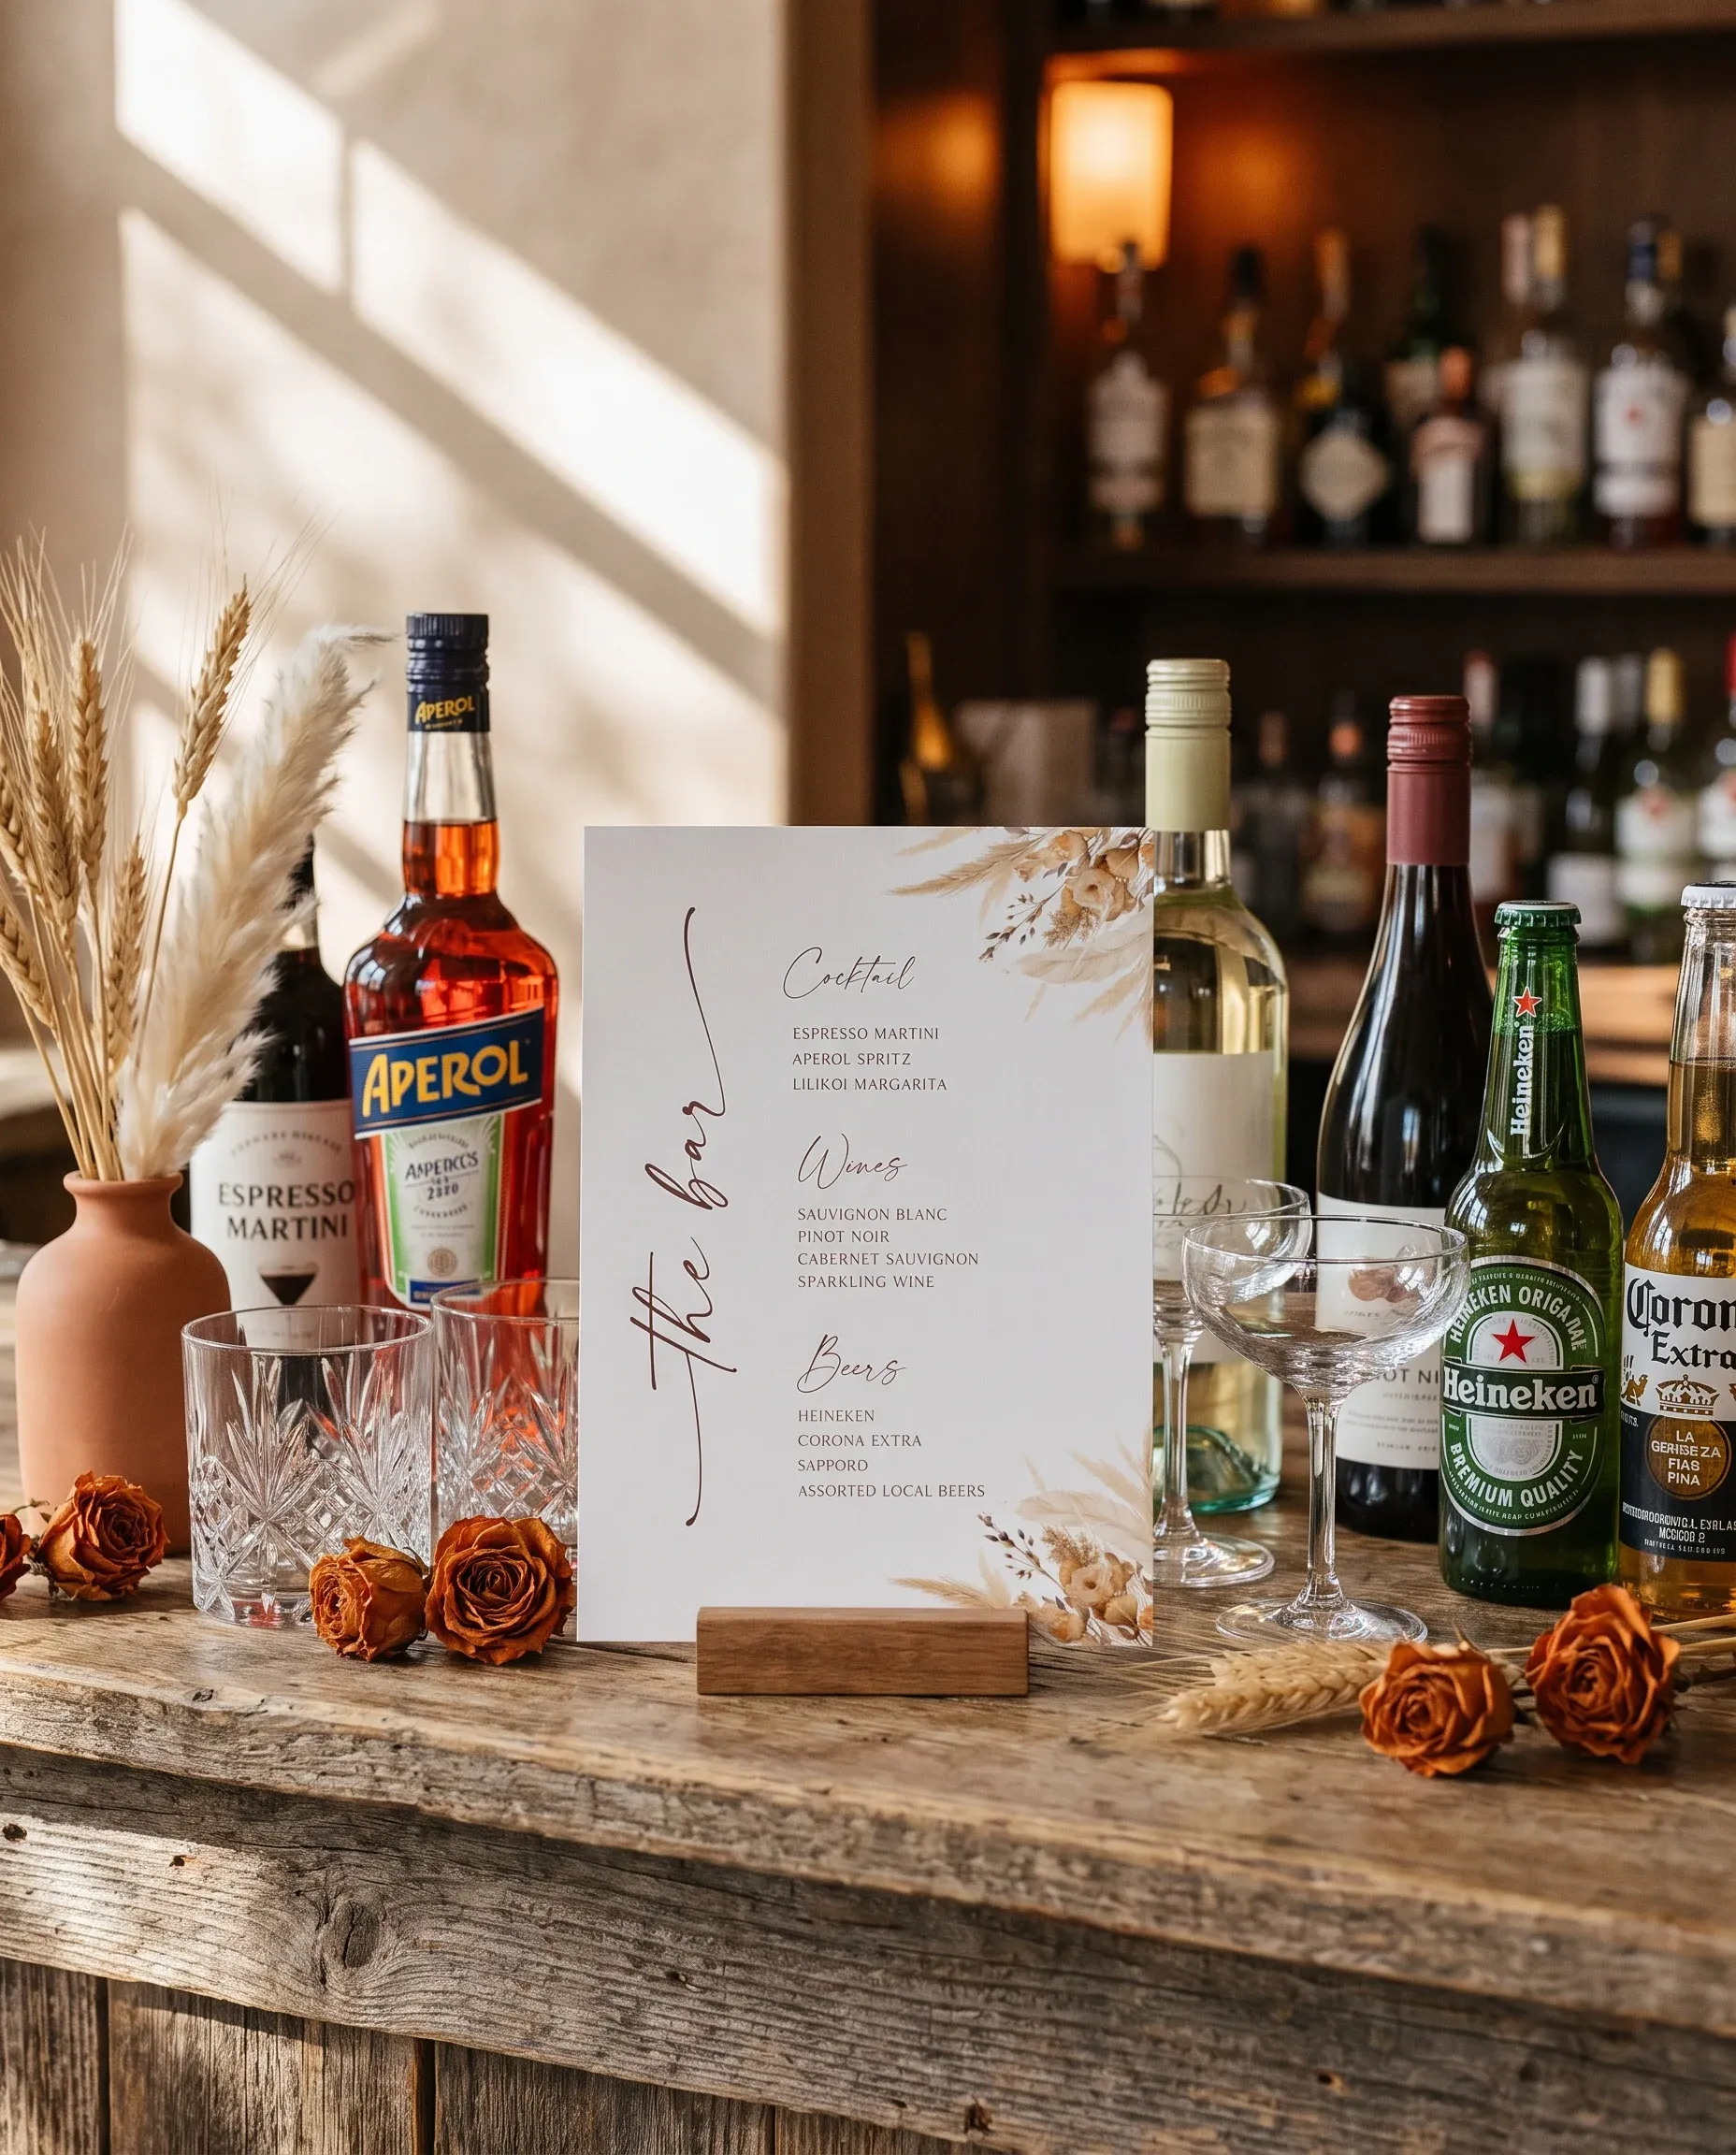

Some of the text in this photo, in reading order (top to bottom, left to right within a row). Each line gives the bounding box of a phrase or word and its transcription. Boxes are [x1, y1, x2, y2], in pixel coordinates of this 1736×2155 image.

[414, 695, 475, 725] APEROL
[783, 947, 916, 1000] Cocktail
[792, 1027, 938, 1040] ESPRESSO MARTINI
[791, 1052, 911, 1065] APEROL SPRITZ
[362, 1039, 528, 1118] APEROL
[792, 1078, 948, 1091] LILIKOI MARGARITA
[1510, 1025, 1534, 1135] Heineken
[798, 1133, 908, 1190] Wines
[218, 1180, 355, 1208] ESPRESSO
[629, 906, 737, 1527] the bar
[797, 1208, 948, 1222] SAUVIGNON BLANC
[227, 1215, 347, 1241] MARTINI
[798, 1230, 890, 1243] PINOT NOIR
[797, 1252, 978, 1266] CABERNET SAUVIGNON
[797, 1275, 934, 1289] SPARKLING WINE
[1450, 1284, 1512, 1344] HEINEKEN
[1651, 1330, 1736, 1369] Extra
[796, 1334, 907, 1394] Beers
[798, 1410, 875, 1423] HEINEKEN
[797, 1434, 922, 1447] CORONA EXTRA
[1676, 1430, 1695, 1443] LA
[1668, 1457, 1700, 1471] FIAS
[1520, 1449, 1584, 1508] QUALITY
[1667, 1471, 1700, 1486] PINA
[798, 1484, 985, 1497] ASSORTED LOCAL BEERS
